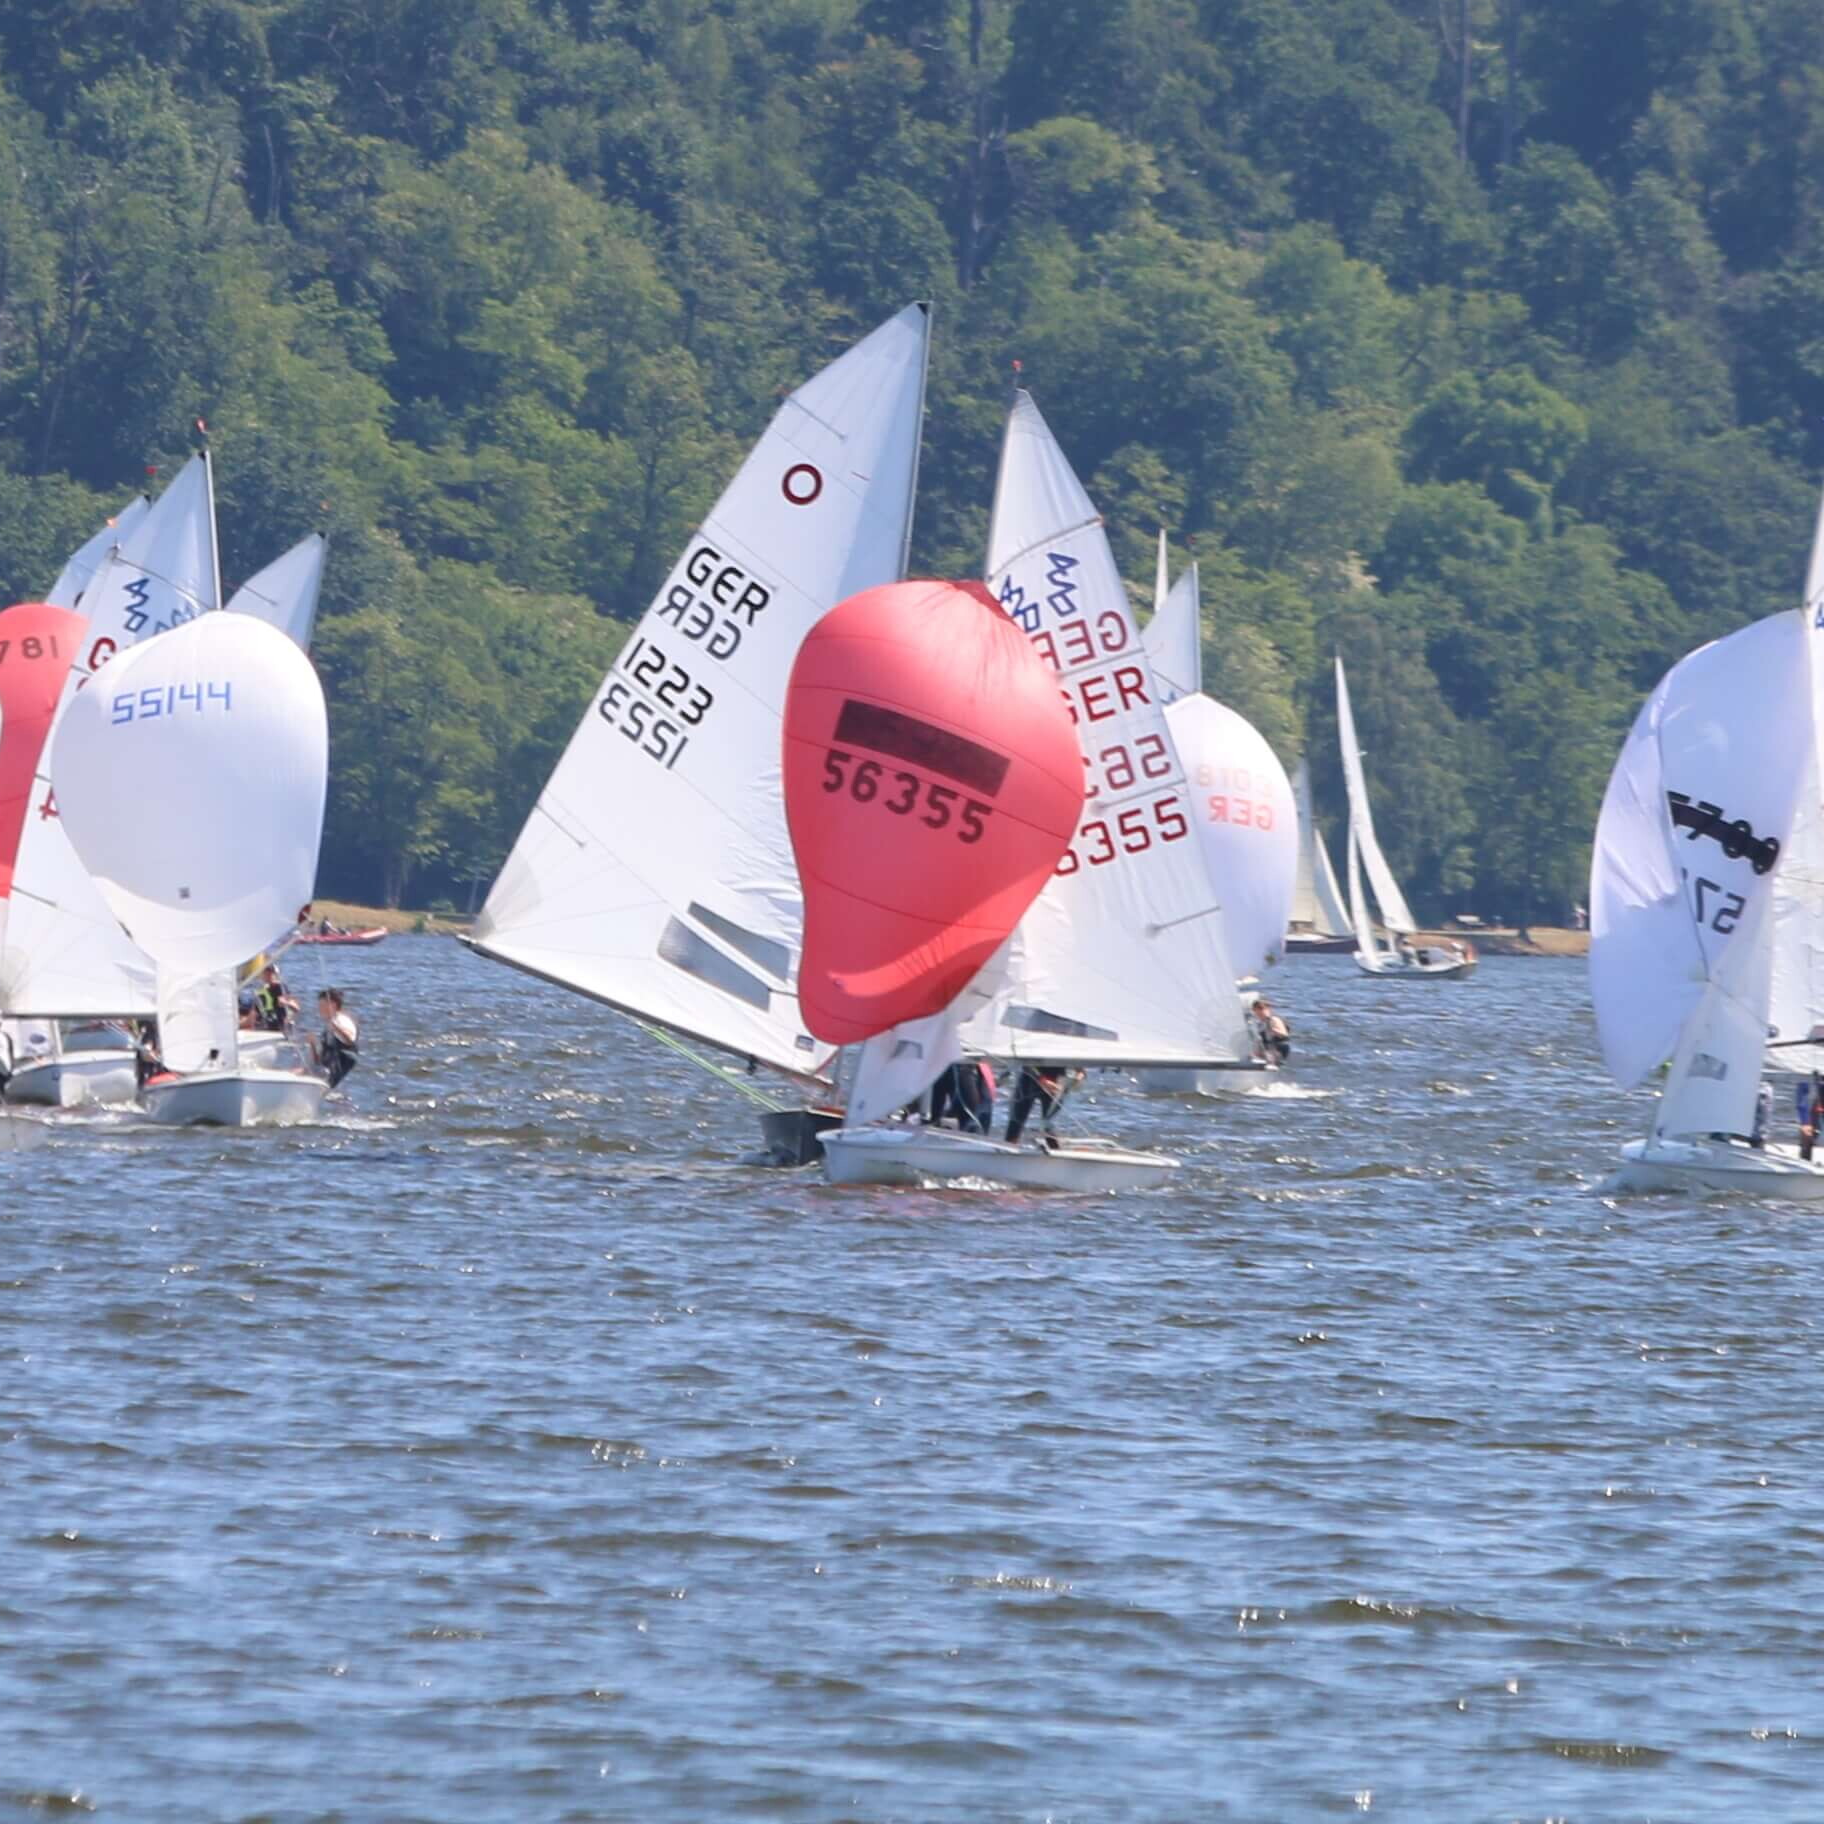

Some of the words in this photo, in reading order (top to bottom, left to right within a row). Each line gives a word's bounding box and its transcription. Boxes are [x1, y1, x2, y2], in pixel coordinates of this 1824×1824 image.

[686, 547, 770, 627] GER
[112, 682, 231, 725] 55144
[624, 638, 714, 726] 1223
[823, 749, 993, 844] 56355
